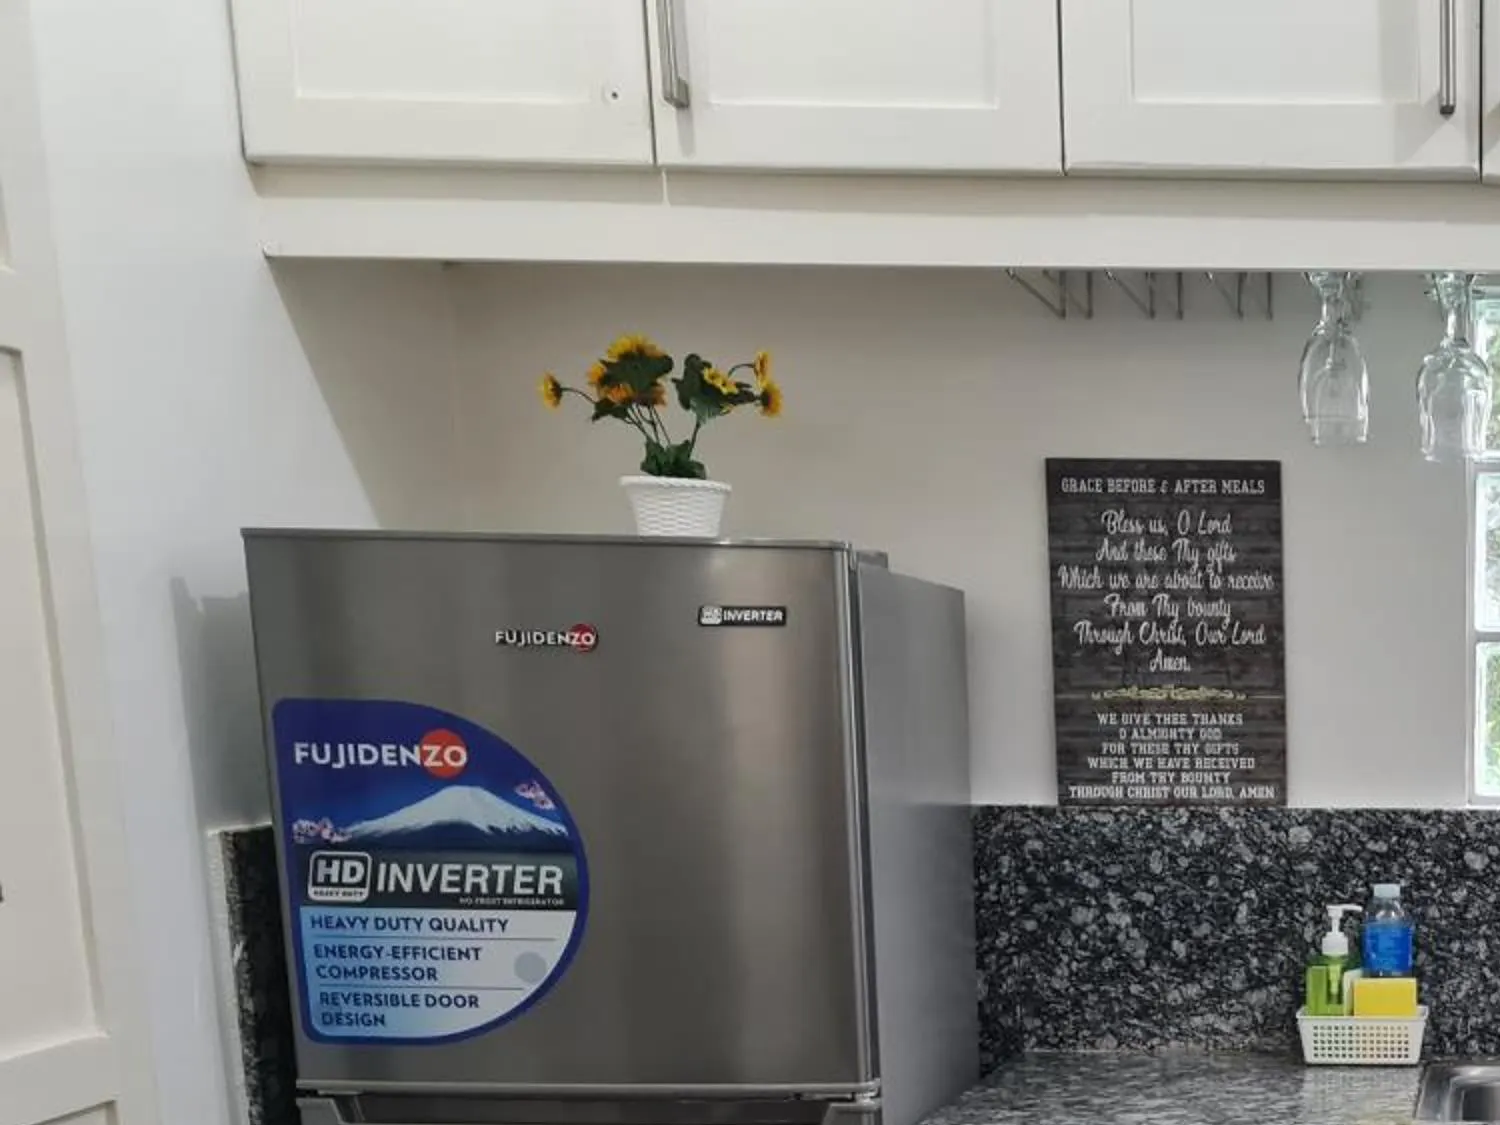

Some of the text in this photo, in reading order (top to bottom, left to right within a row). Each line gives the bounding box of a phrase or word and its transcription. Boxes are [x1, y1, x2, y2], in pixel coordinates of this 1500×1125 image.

[1061, 478, 1102, 493] GRACE
[1107, 478, 1155, 493] BEFORE
[1174, 479, 1217, 494] AFTER
[1222, 479, 1265, 494] MEALS
[1101, 508, 1144, 535] Bless
[1177, 508, 1191, 535] O
[1197, 509, 1232, 535] Lord
[1096, 537, 1238, 574] And these Thy gifts
[1058, 565, 1275, 590] Which we are about to receive
[724, 609, 783, 621] INVERTER
[1103, 593, 1231, 629] From Thy bounty
[495, 631, 597, 647] FUJIDENZO
[1073, 619, 1136, 655] Through
[1195, 621, 1227, 646] Our
[1232, 621, 1267, 645] Lord
[1150, 648, 1192, 672] Amen.
[1098, 713, 1243, 725] WE GIVE THEE THANKS
[1131, 728, 1195, 740] ALMIGHTY
[1199, 728, 1222, 740] GOD
[294, 742, 468, 768] FUJIDENZO
[1102, 742, 1239, 755] FOR THESE THY GIFTS
[1087, 757, 1255, 769] WHICH WE HAVE RECEIVED
[1111, 772, 1231, 784] FROM THY BOUNTY
[1068, 786, 1123, 799] THROUGH
[1127, 786, 1169, 799] CHRIST
[1173, 786, 1197, 799] OUR
[317, 859, 563, 895] HD INVERTER
[311, 916, 509, 934] HEAVY DUTY QUALITY
[314, 944, 482, 962] ENERGY-EFFICIENT
[316, 965, 438, 981] COMPRESSOR
[320, 992, 479, 1009] REVERSIBLE DOOR
[322, 1012, 386, 1027] DESIGN
